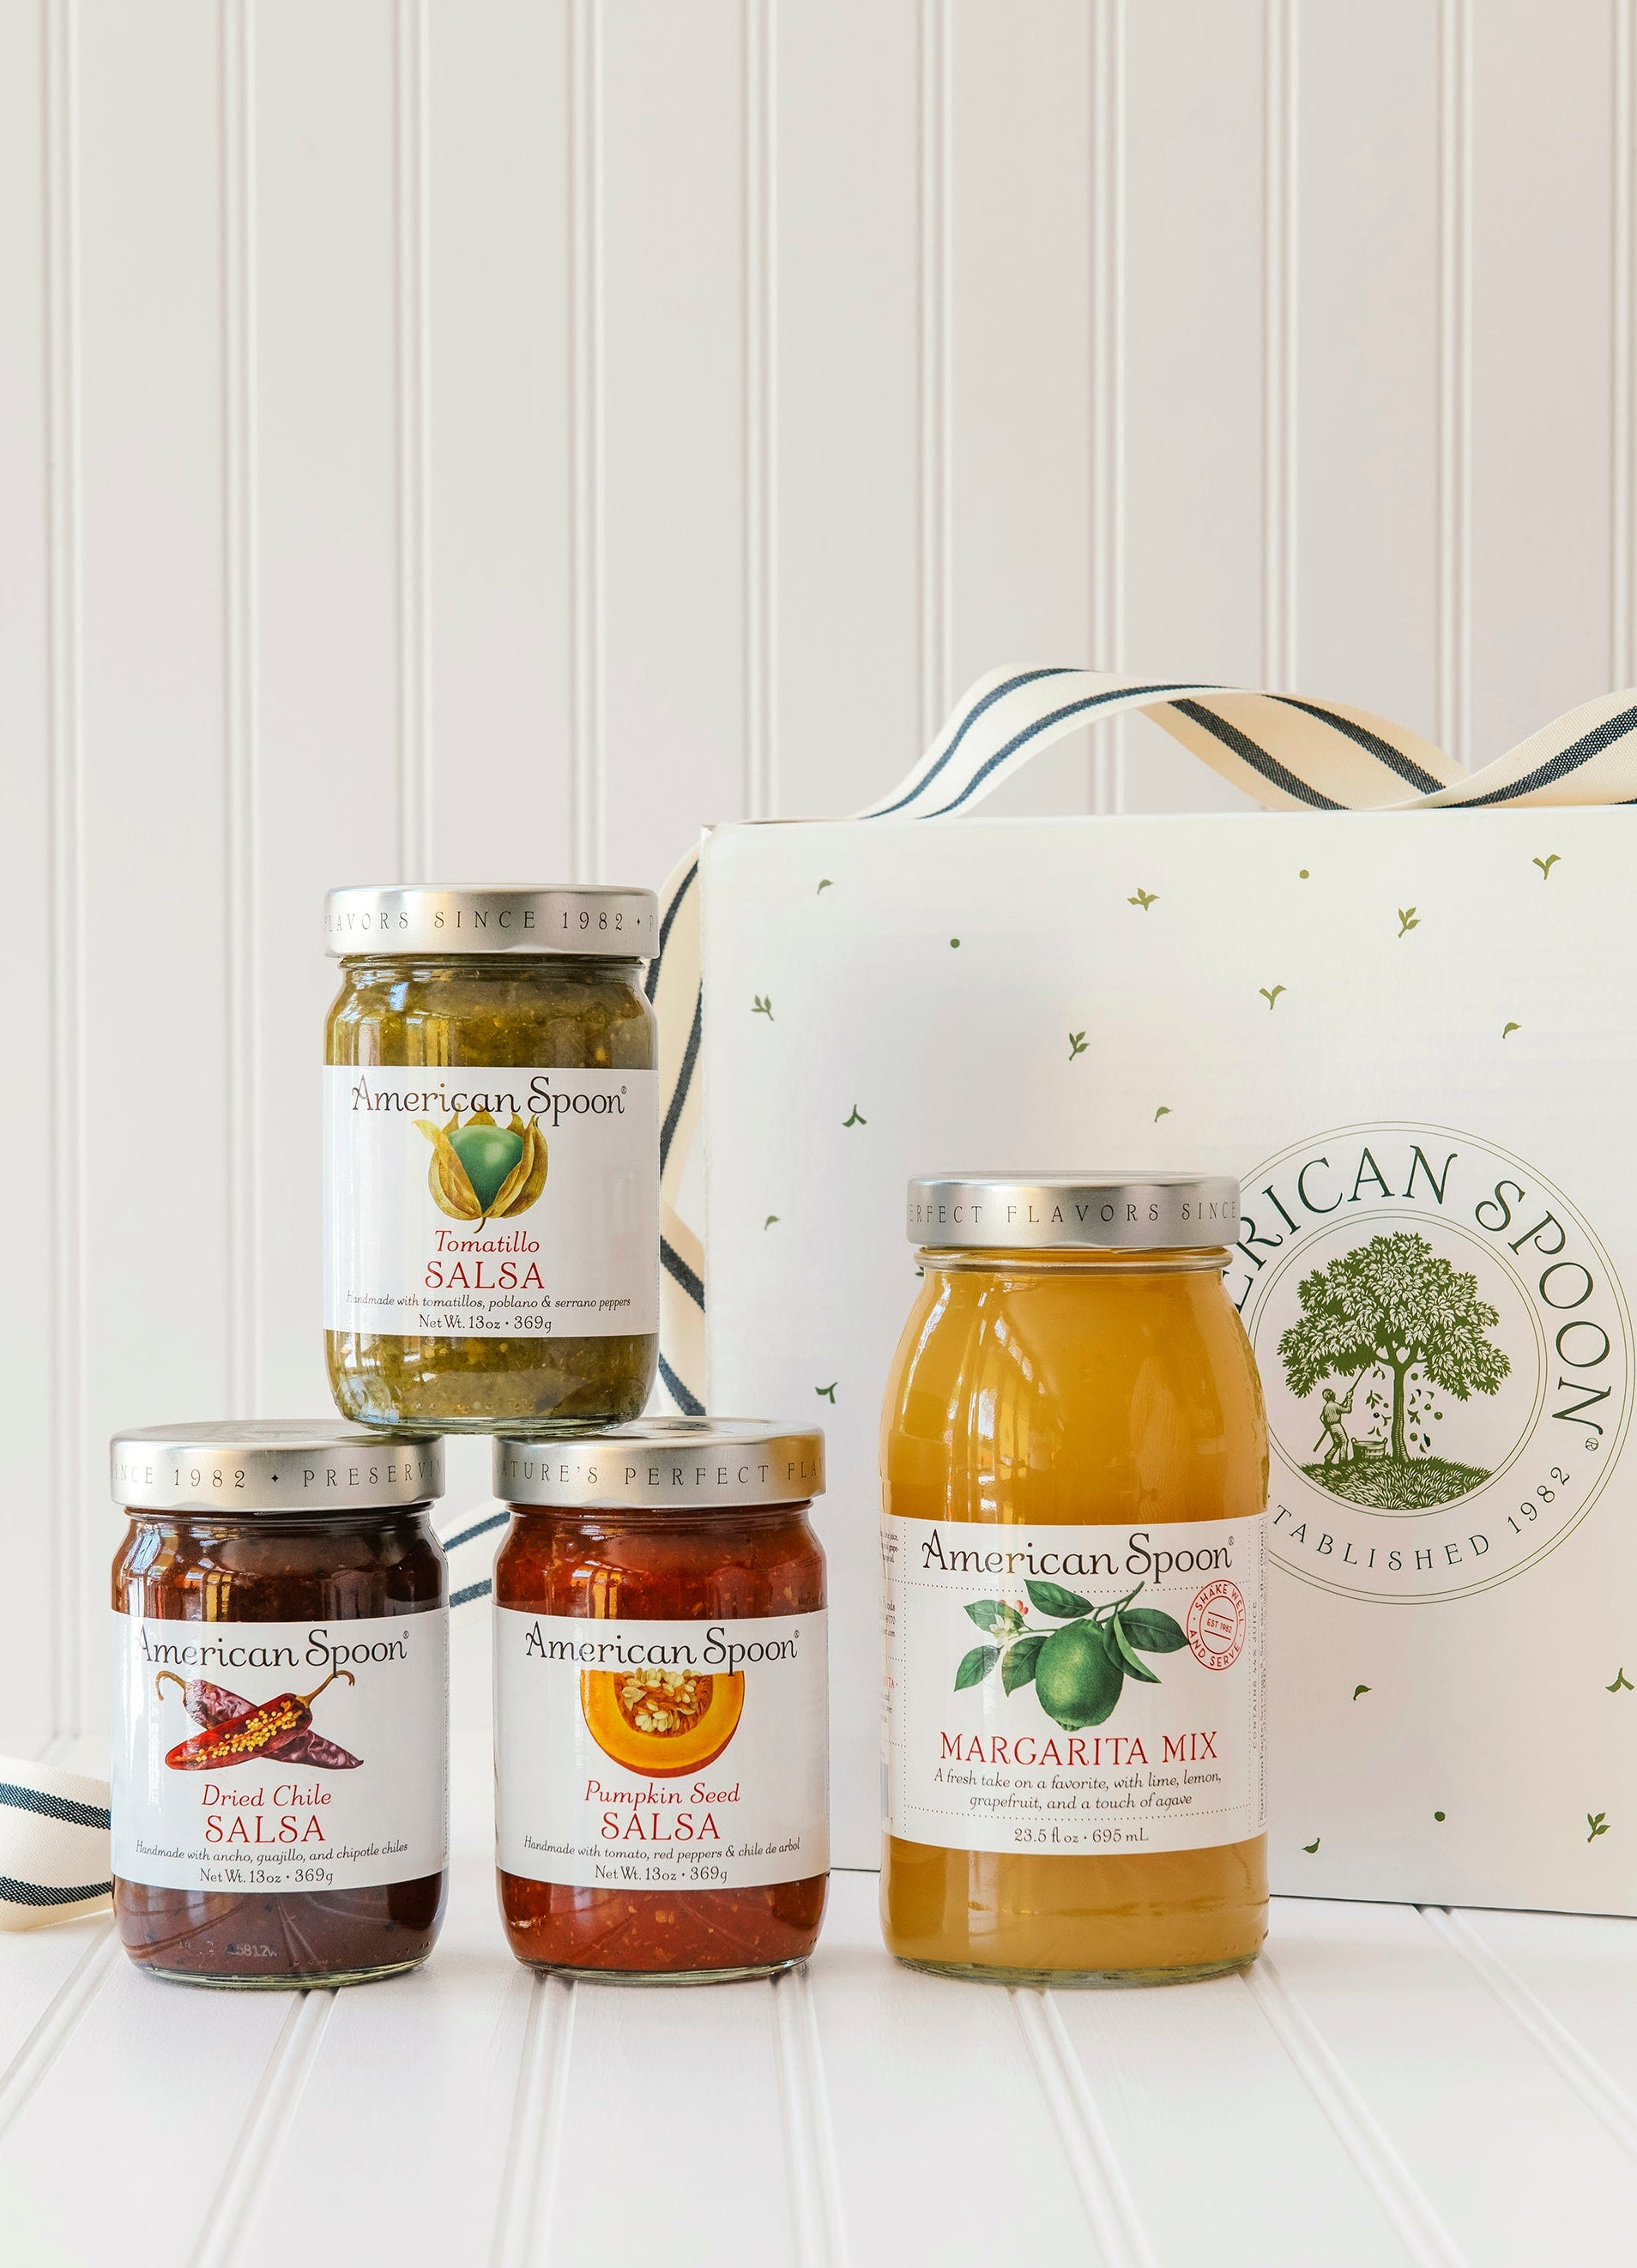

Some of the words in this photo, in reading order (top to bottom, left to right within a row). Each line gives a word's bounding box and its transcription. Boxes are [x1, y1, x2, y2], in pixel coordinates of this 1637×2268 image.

[434, 910, 536, 929] SINCE
[562, 911, 625, 932] 1982
[351, 1074, 521, 1113] American
[909, 1203, 983, 1223] ERFECT
[1006, 1203, 1158, 1223] FLAVORS
[1181, 1201, 1235, 1221] SINCE
[435, 1230, 540, 1253] Tomatillo
[425, 1261, 545, 1289] SALSA
[347, 1289, 395, 1306] Handmade
[397, 1293, 420, 1306] with
[422, 1294, 486, 1311] tomatillos,
[489, 1294, 538, 1312] poblano
[541, 1295, 552, 1308] &
[554, 1298, 596, 1309] serrano
[599, 1297, 631, 1311] peppers
[419, 1314, 440, 1329] Net
[441, 1314, 465, 1330] Wt.
[468, 1315, 501, 1330] 13oz
[514, 1315, 552, 1335] 369g
[174, 1469, 246, 1488] 1982
[500, 1460, 598, 1485] ATURE'S
[625, 1464, 770, 1487] PERFECT
[1268, 1494, 1490, 1571] TABLISHED
[1507, 1463, 1571, 1535] 1982
[921, 1528, 1118, 1575] American
[1195, 1583, 1229, 1612] SHAKE
[1231, 1589, 1245, 1625] WELL
[1206, 1618, 1218, 1628] EST
[135, 1625, 299, 1668] American
[525, 1620, 697, 1665] American
[1189, 1630, 1206, 1658] AND
[1209, 1642, 1241, 1667] SERVE
[939, 1730, 1150, 1765] MARGARITA
[1161, 1730, 1218, 1764] MIX
[933, 1768, 945, 1783] A
[945, 1769, 977, 1787] fresh
[981, 1771, 1011, 1788] take
[1013, 1777, 1034, 1789] on
[1036, 1777, 1047, 1789] a
[1049, 1772, 1109, 1792] favorite,
[1113, 1771, 1144, 1788] with
[1146, 1770, 1179, 1788] lime,
[1181, 1767, 1222, 1786] lemon,
[202, 1783, 265, 1807] Dried
[273, 1783, 332, 1806] Chile
[584, 1780, 683, 1811] Pumpkin
[690, 1781, 740, 1804] Seed
[969, 1791, 1044, 1812] grapefruit,
[1046, 1793, 1077, 1810] and
[1080, 1797, 1091, 1810] a
[1095, 1792, 1137, 1809] touch
[1139, 1791, 1156, 1811] of
[1155, 1794, 1193, 1812] agave
[204, 1814, 326, 1844] SALSA
[601, 1812, 721, 1841] SALSA
[1013, 1827, 1048, 1844] 23.5
[1050, 1826, 1063, 1844] fl
[1063, 1833, 1079, 1844] oz
[1091, 1827, 1122, 1844] 695
[1125, 1827, 1150, 1843] mL
[136, 1840, 185, 1860] Handmade
[186, 1845, 211, 1861] with
[213, 1846, 254, 1864] ancho,
[257, 1846, 306, 1866] guajillo,
[309, 1846, 335, 1861] and
[336, 1843, 380, 1861] chipotle
[381, 1840, 408, 1854] chiles
[523, 1835, 576, 1855] Handmade
[577, 1843, 601, 1858] with
[603, 1847, 650, 1861] tomato,
[652, 1847, 674, 1861] red
[676, 1849, 723, 1863] peppers
[725, 1845, 735, 1858] &
[738, 1843, 764, 1857] chile
[764, 1842, 777, 1854] de
[778, 1837, 800, 1854] arbol
[199, 1868, 223, 1883] Net
[225, 1869, 246, 1884] Wt.
[249, 1870, 282, 1884] 13oz
[294, 1867, 334, 1885] 369g
[594, 1864, 619, 1879] Net
[619, 1865, 642, 1880] Wt.
[645, 1866, 677, 1880] 13oz
[689, 1865, 728, 1885] 369g
